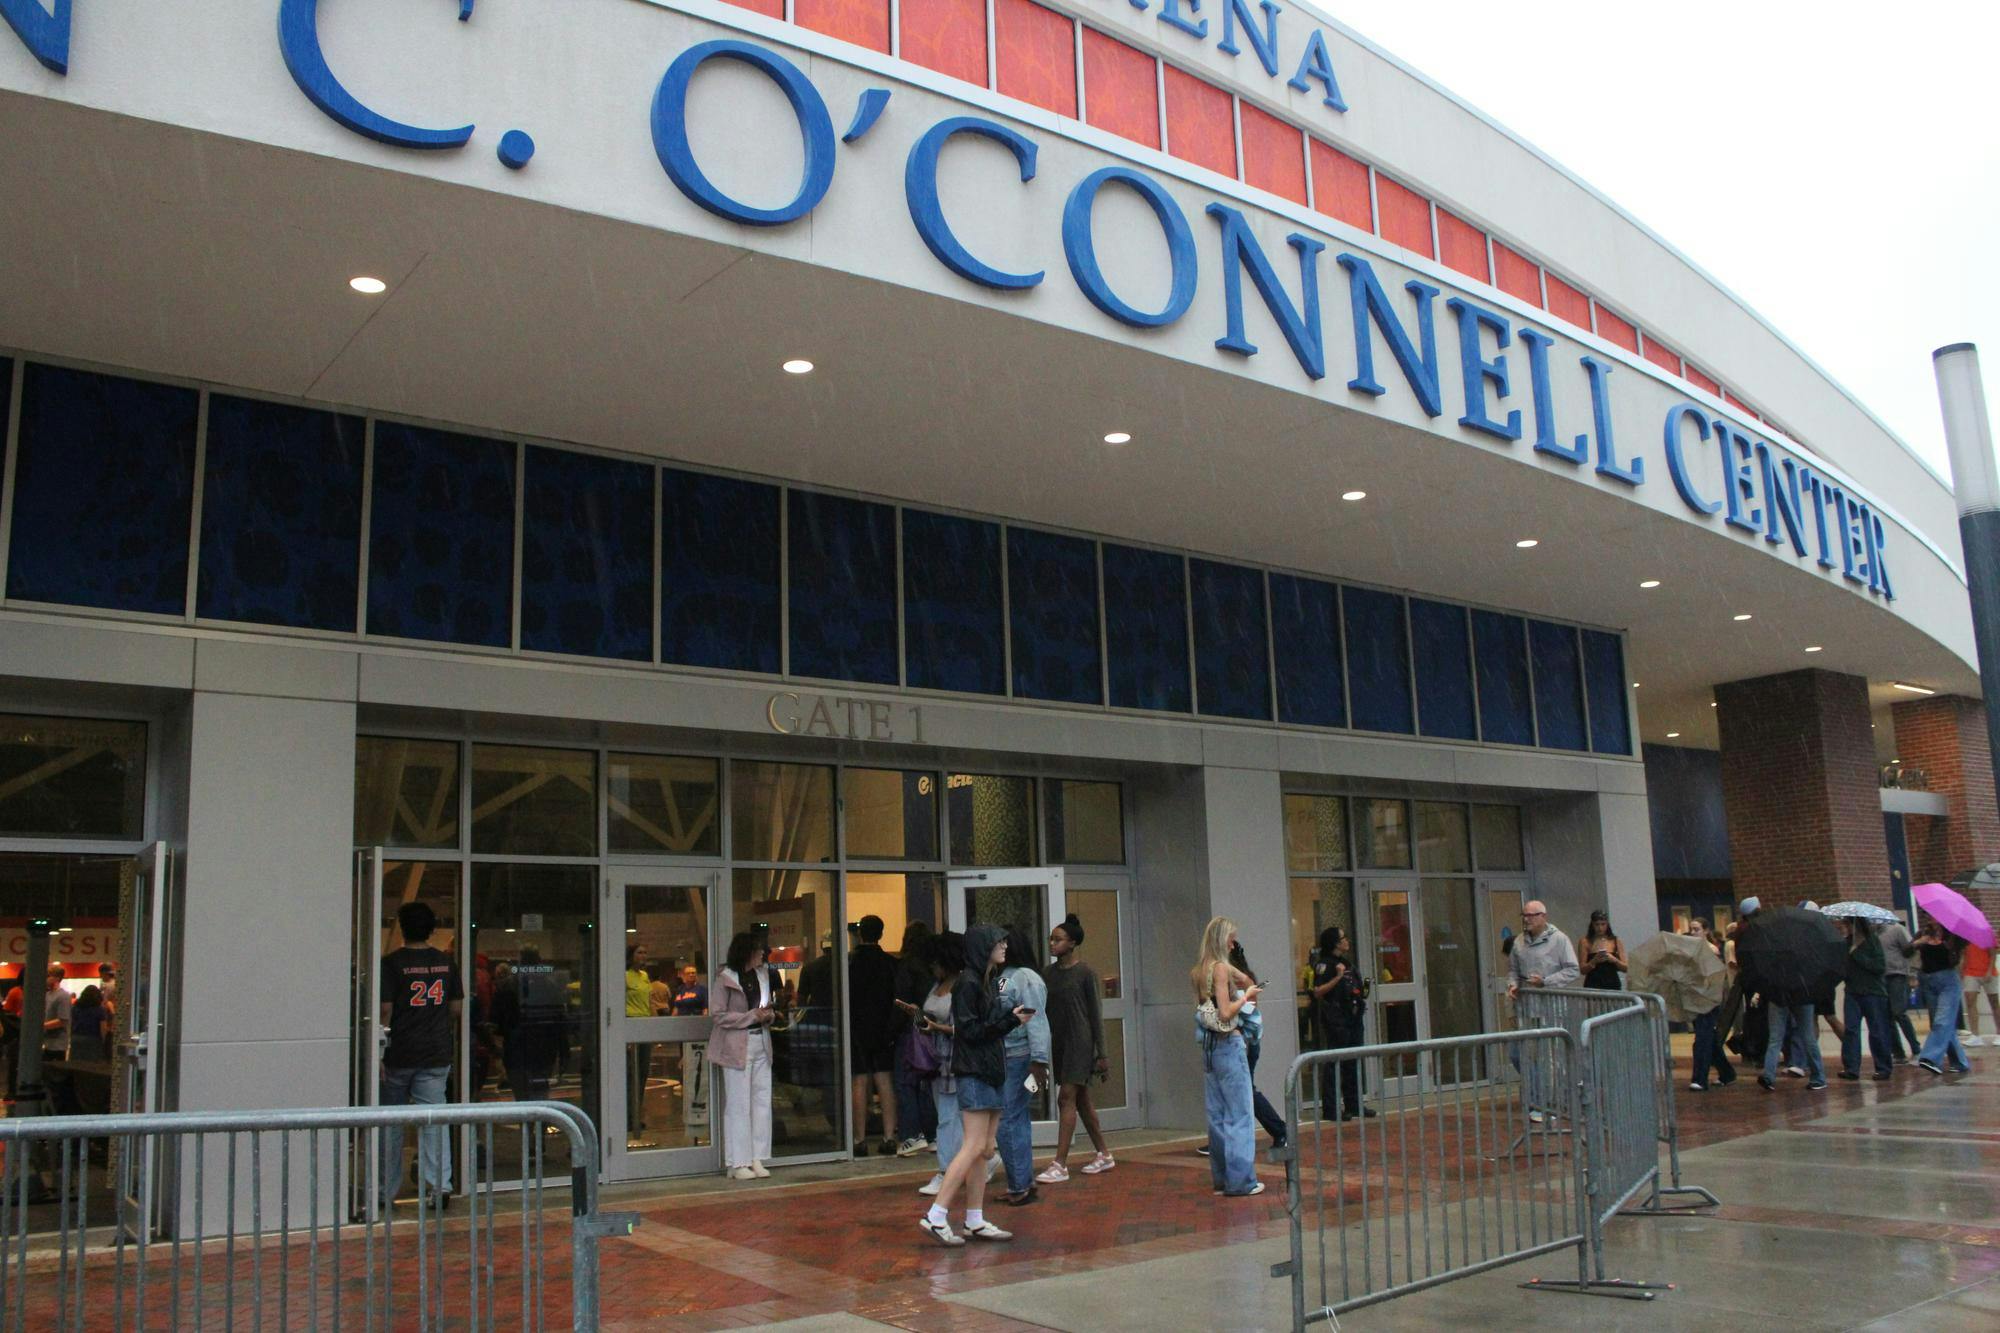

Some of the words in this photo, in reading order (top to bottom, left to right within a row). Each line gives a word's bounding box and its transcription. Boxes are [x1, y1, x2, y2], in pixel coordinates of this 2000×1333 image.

[649, 38, 1646, 486] O'CONNELL
[1663, 401, 1895, 600] CENTER
[767, 691, 894, 741] GATE
[908, 705, 928, 744] 1
[410, 979, 444, 1006] 24
